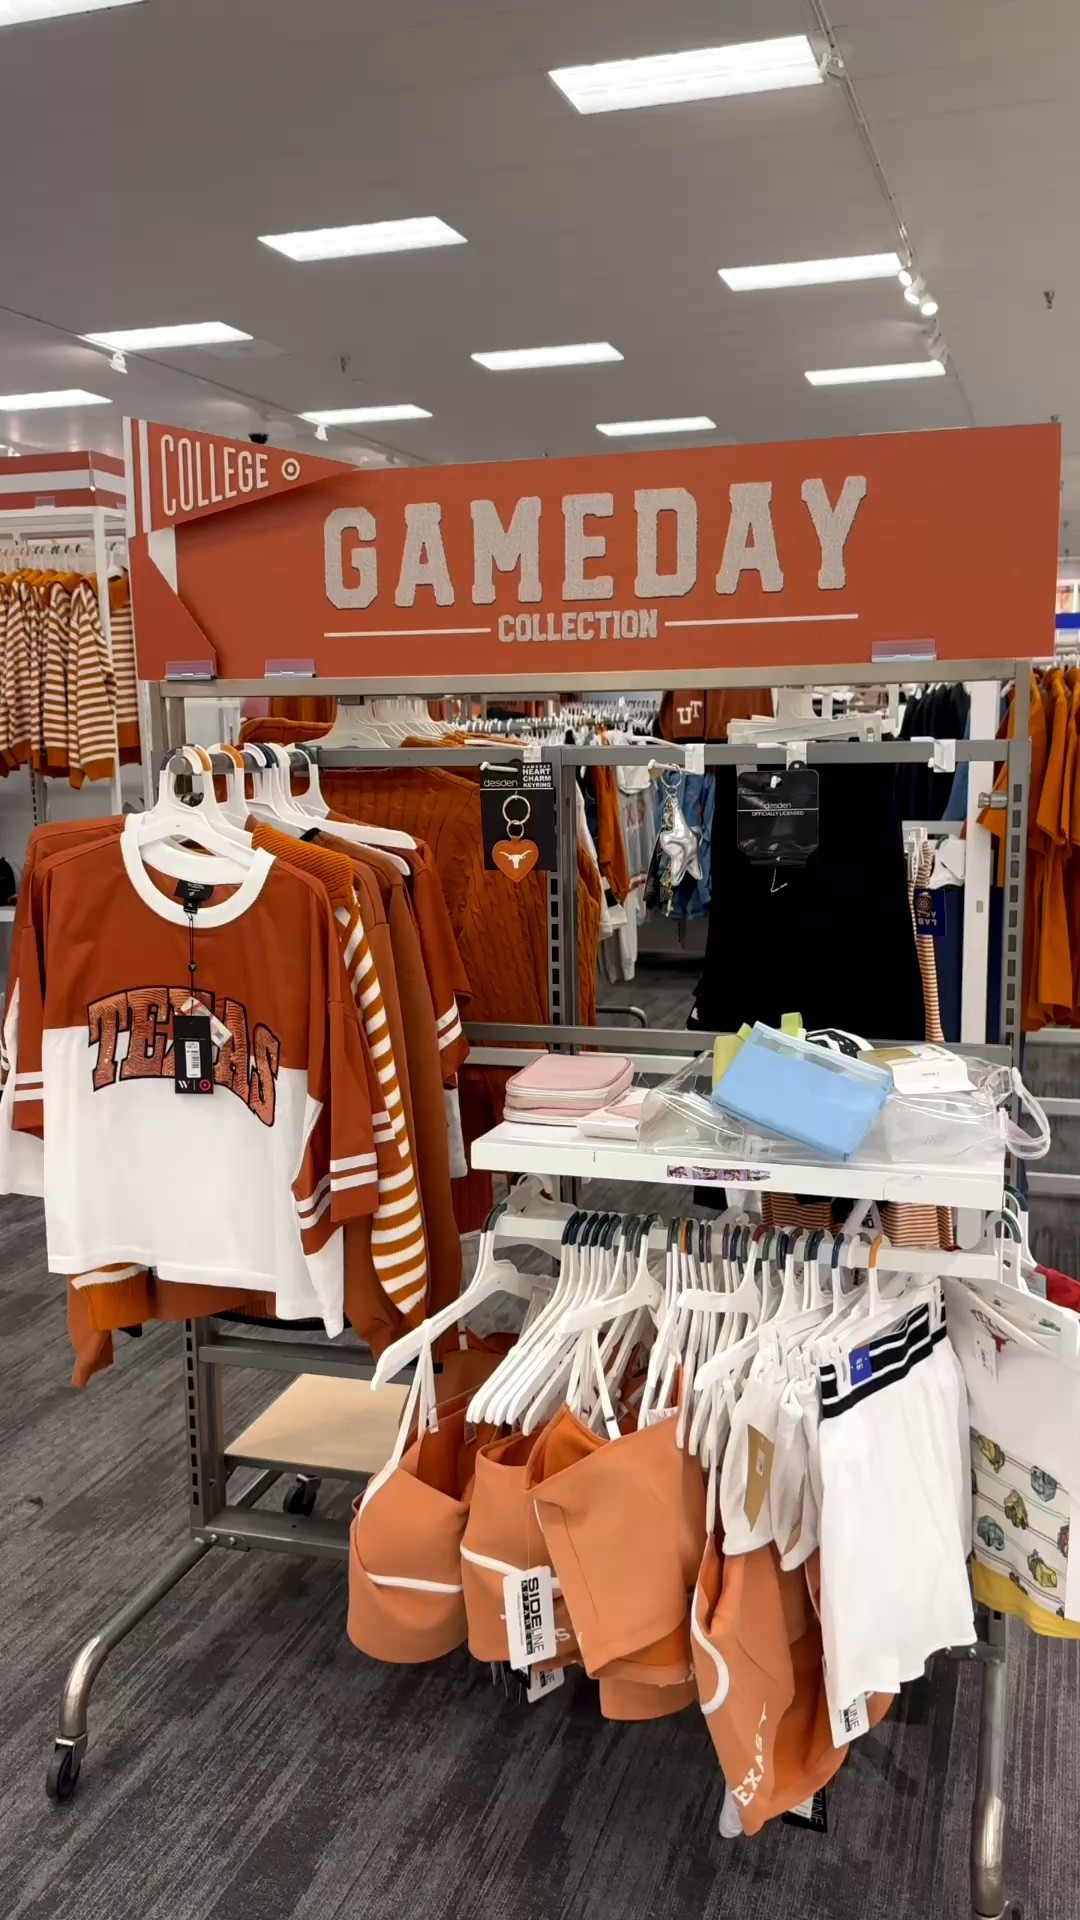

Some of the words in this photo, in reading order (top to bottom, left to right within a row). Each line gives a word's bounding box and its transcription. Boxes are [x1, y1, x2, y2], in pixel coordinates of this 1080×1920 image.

[161, 434, 269, 516] COLLEGE
[323, 475, 867, 609] GAMEDAY
[498, 609, 658, 642] COLLECTION
[677, 701, 702, 725] UT
[483, 779, 518, 788] desden
[522, 768, 552, 776] HEART
[522, 775, 552, 783] CHARM
[528, 1576, 545, 1654] SIDELINE
